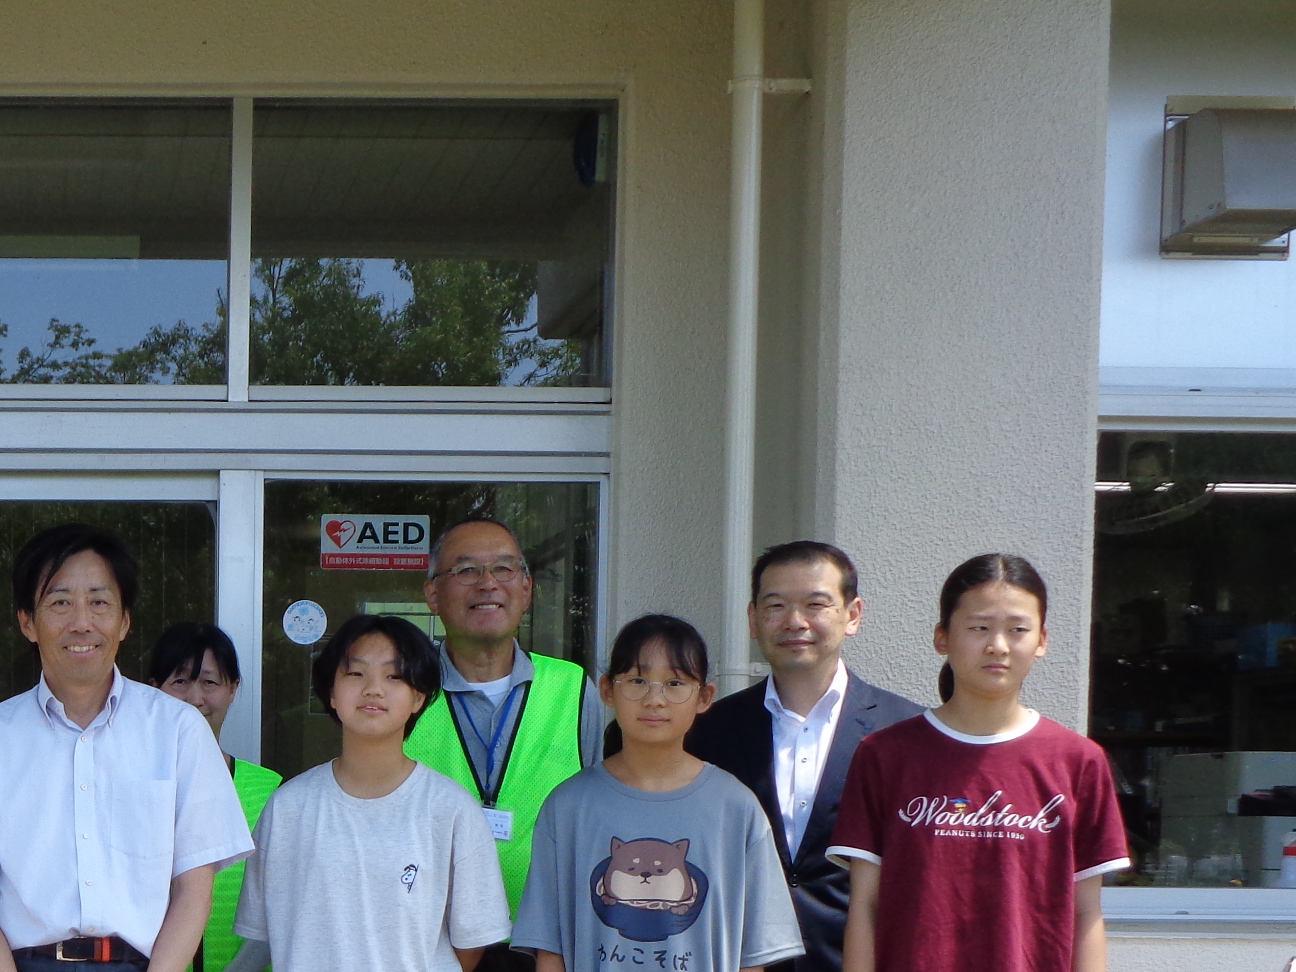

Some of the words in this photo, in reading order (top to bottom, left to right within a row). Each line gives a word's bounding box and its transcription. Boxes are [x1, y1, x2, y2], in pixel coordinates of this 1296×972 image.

[357, 522, 425, 544] AED
[898, 790, 1065, 833] Woodstock
[934, 829, 976, 838] PEANUTS
[1006, 831, 1025, 840] 1950
